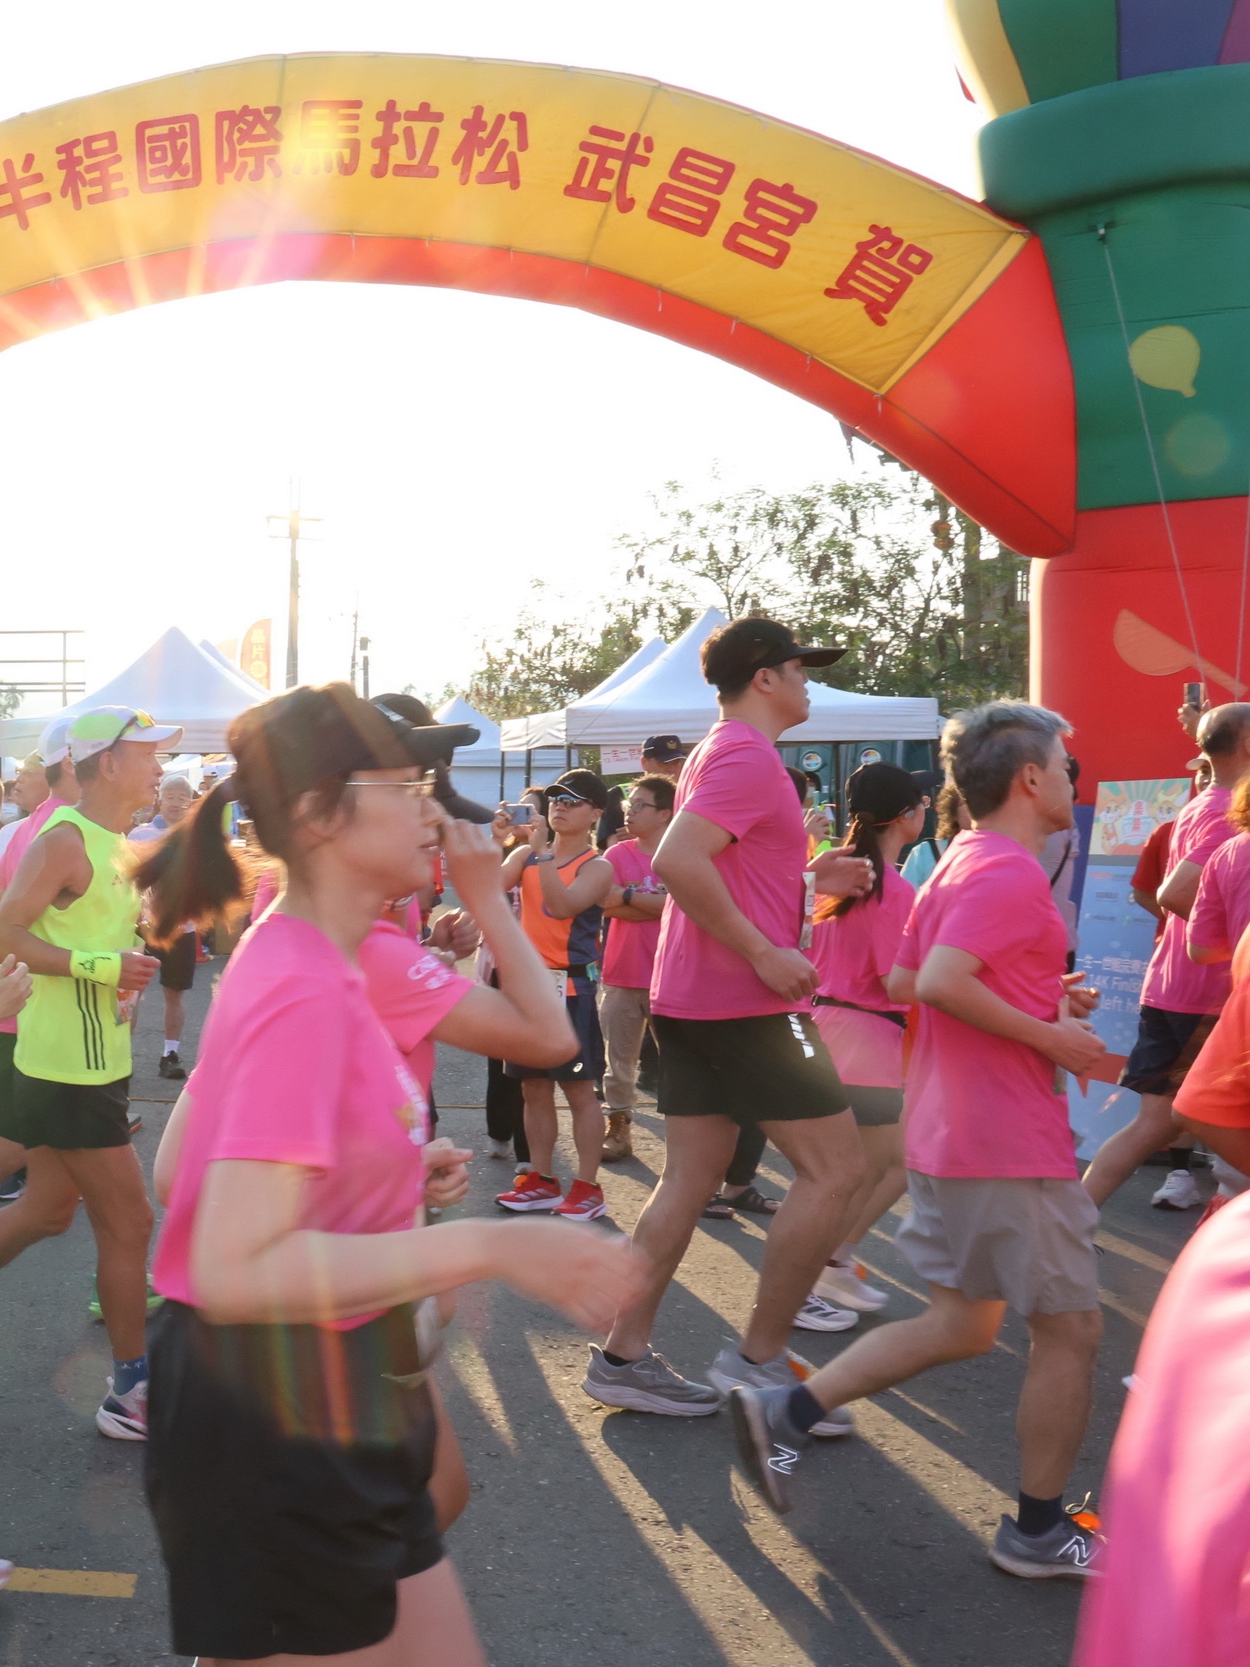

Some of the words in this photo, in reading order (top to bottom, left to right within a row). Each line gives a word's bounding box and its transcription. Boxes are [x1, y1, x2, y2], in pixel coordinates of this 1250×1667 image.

[562, 123, 818, 270] 武昌宮
[823, 223, 933, 328] 賀
